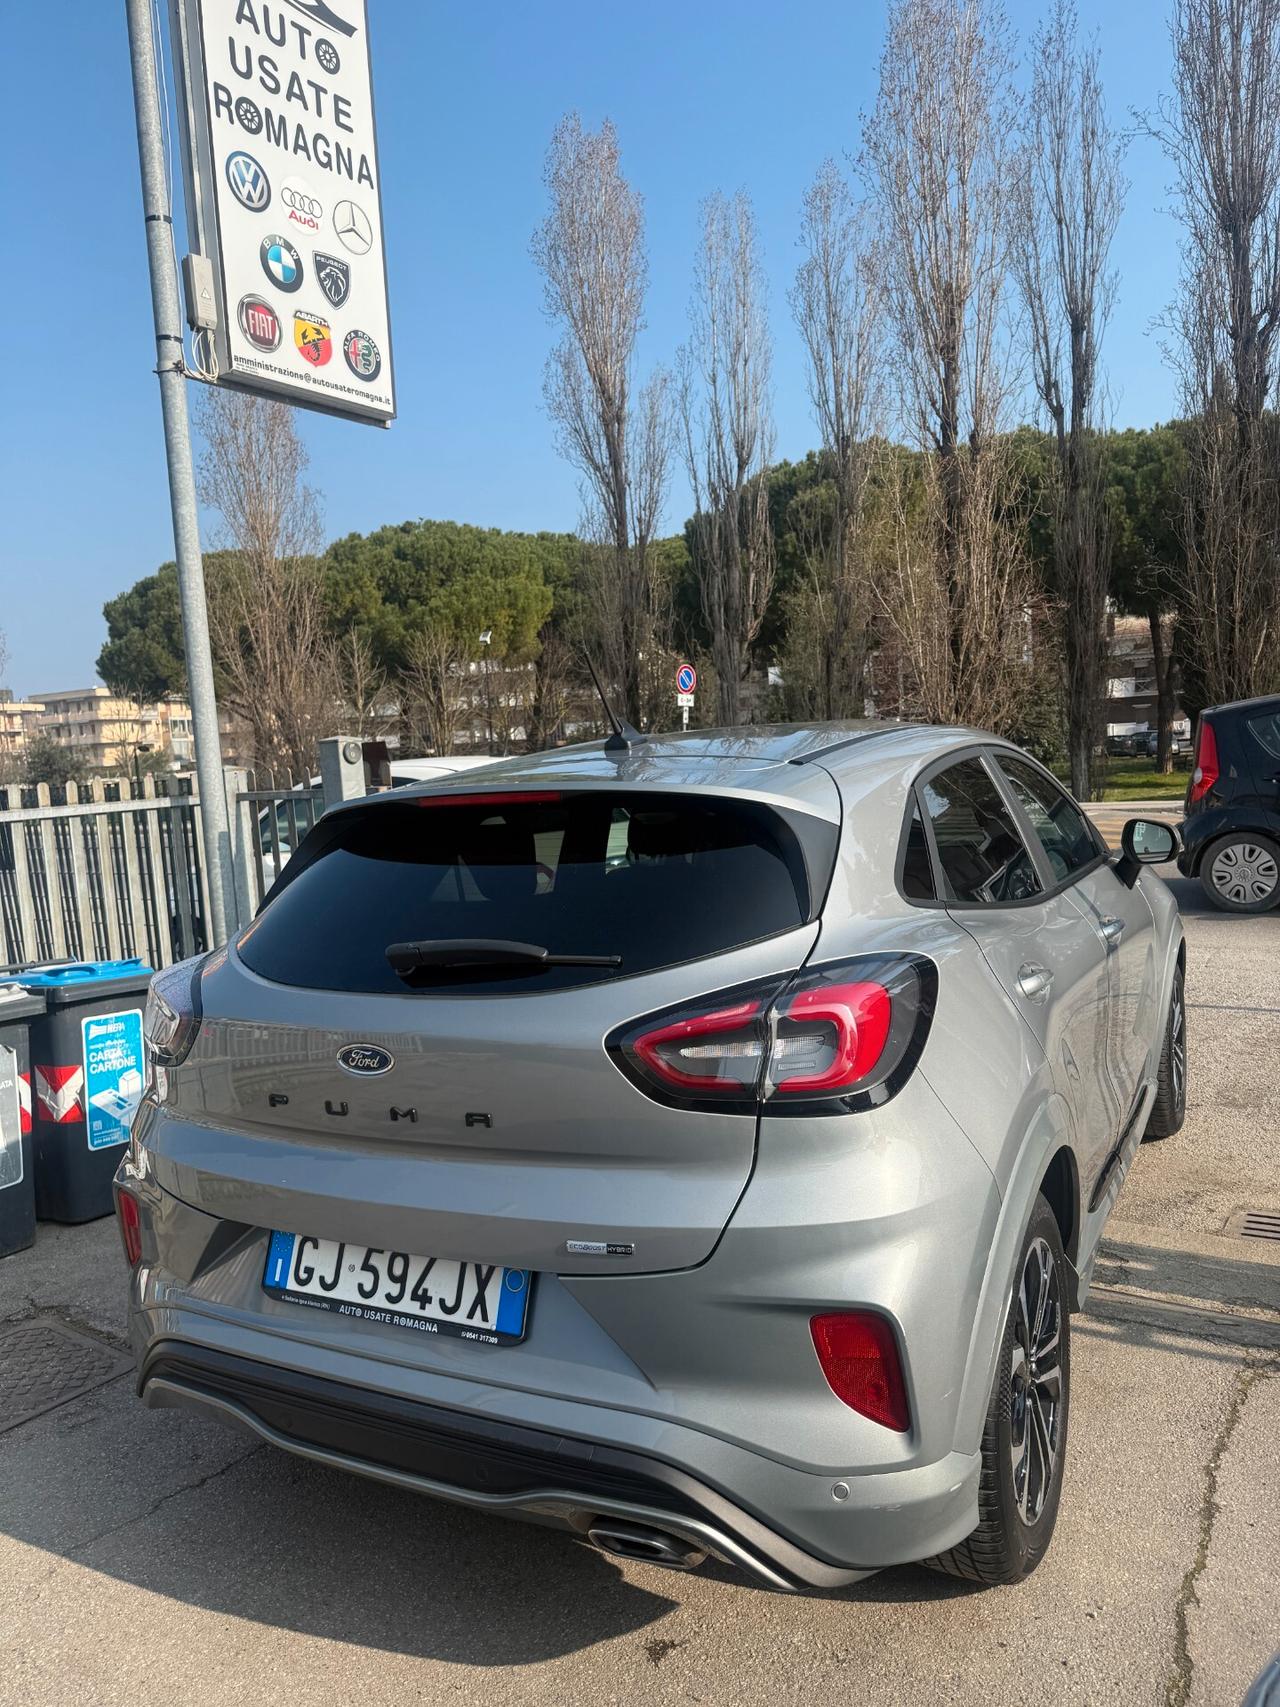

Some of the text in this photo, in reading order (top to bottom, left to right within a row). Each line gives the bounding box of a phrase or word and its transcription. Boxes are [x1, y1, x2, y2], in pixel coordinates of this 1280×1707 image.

[236, 0, 340, 75] AUTO
[228, 36, 353, 133] USATE
[213, 81, 374, 190] ROMAGNA
[288, 210, 319, 231] Audi
[263, 235, 299, 260] BMW
[316, 255, 347, 271] PEUGEOT
[248, 309, 274, 341] FIAT
[295, 311, 329, 327] ABARTH
[343, 331, 380, 361] ALFA ROMEO
[233, 354, 391, 406] amministrazione@autousateromagna.it
[90, 1055, 136, 1075] CARTONE
[349, 1049, 380, 1068] Ford
[268, 1093, 493, 1128] PUMA
[607, 1246, 632, 1254] HYBRID
[338, 1304, 438, 1333] AUTO USATE ROMAGNA
